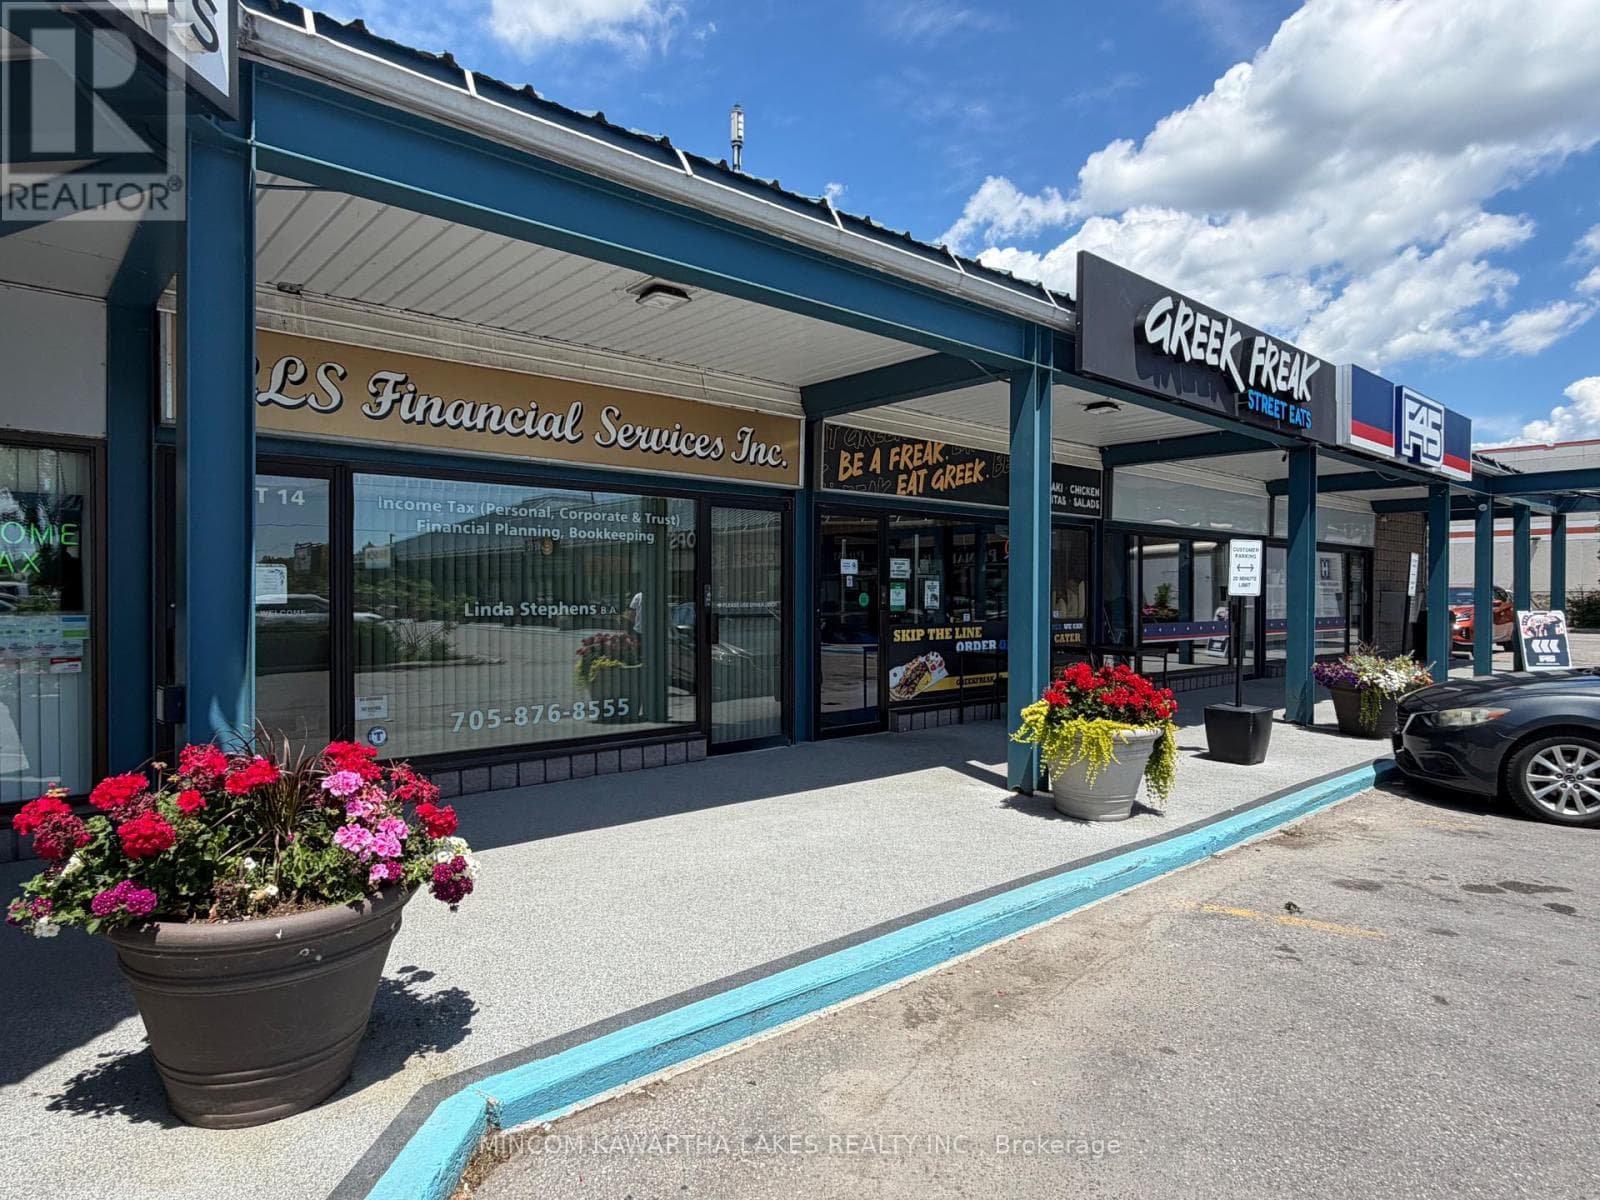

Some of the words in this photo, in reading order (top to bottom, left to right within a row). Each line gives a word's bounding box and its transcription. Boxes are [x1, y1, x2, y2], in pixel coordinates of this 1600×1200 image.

[1145, 296, 1245, 393] GREEK
[1249, 336, 1320, 402] FREAK
[254, 355, 348, 414] LS
[361, 370, 583, 437] Financial
[594, 405, 725, 460] Services
[730, 426, 788, 468] Inc.
[1248, 389, 1288, 420] STREET
[1289, 402, 1312, 429] EATS
[838, 449, 865, 481] BE
[869, 447, 881, 474] A
[889, 440, 949, 471] FREAK.
[897, 469, 928, 496] EAT
[931, 458, 989, 492] GREEK.
[277, 489, 306, 506] 14
[1070, 484, 1100, 497] CHICKEN
[378, 496, 441, 512] Income
[447, 500, 475, 514] Tax
[480, 501, 555, 520] (Personal,
[559, 507, 628, 523] Corporate
[631, 512, 641, 523] &
[645, 513, 680, 527] Trust)
[1073, 497, 1100, 510] SALADS
[417, 519, 490, 535] Financial
[495, 523, 564, 541] Planning,
[569, 527, 655, 544] Bookkeeping
[464, 602, 514, 617] Linda
[520, 601, 597, 619] Stephens
[893, 628, 925, 642] SKIP
[927, 628, 953, 640] THE
[954, 626, 983, 639] LINE
[956, 640, 997, 652] ORDER
[1054, 633, 1081, 643] CATER
[450, 698, 630, 733] 705-876-8555
